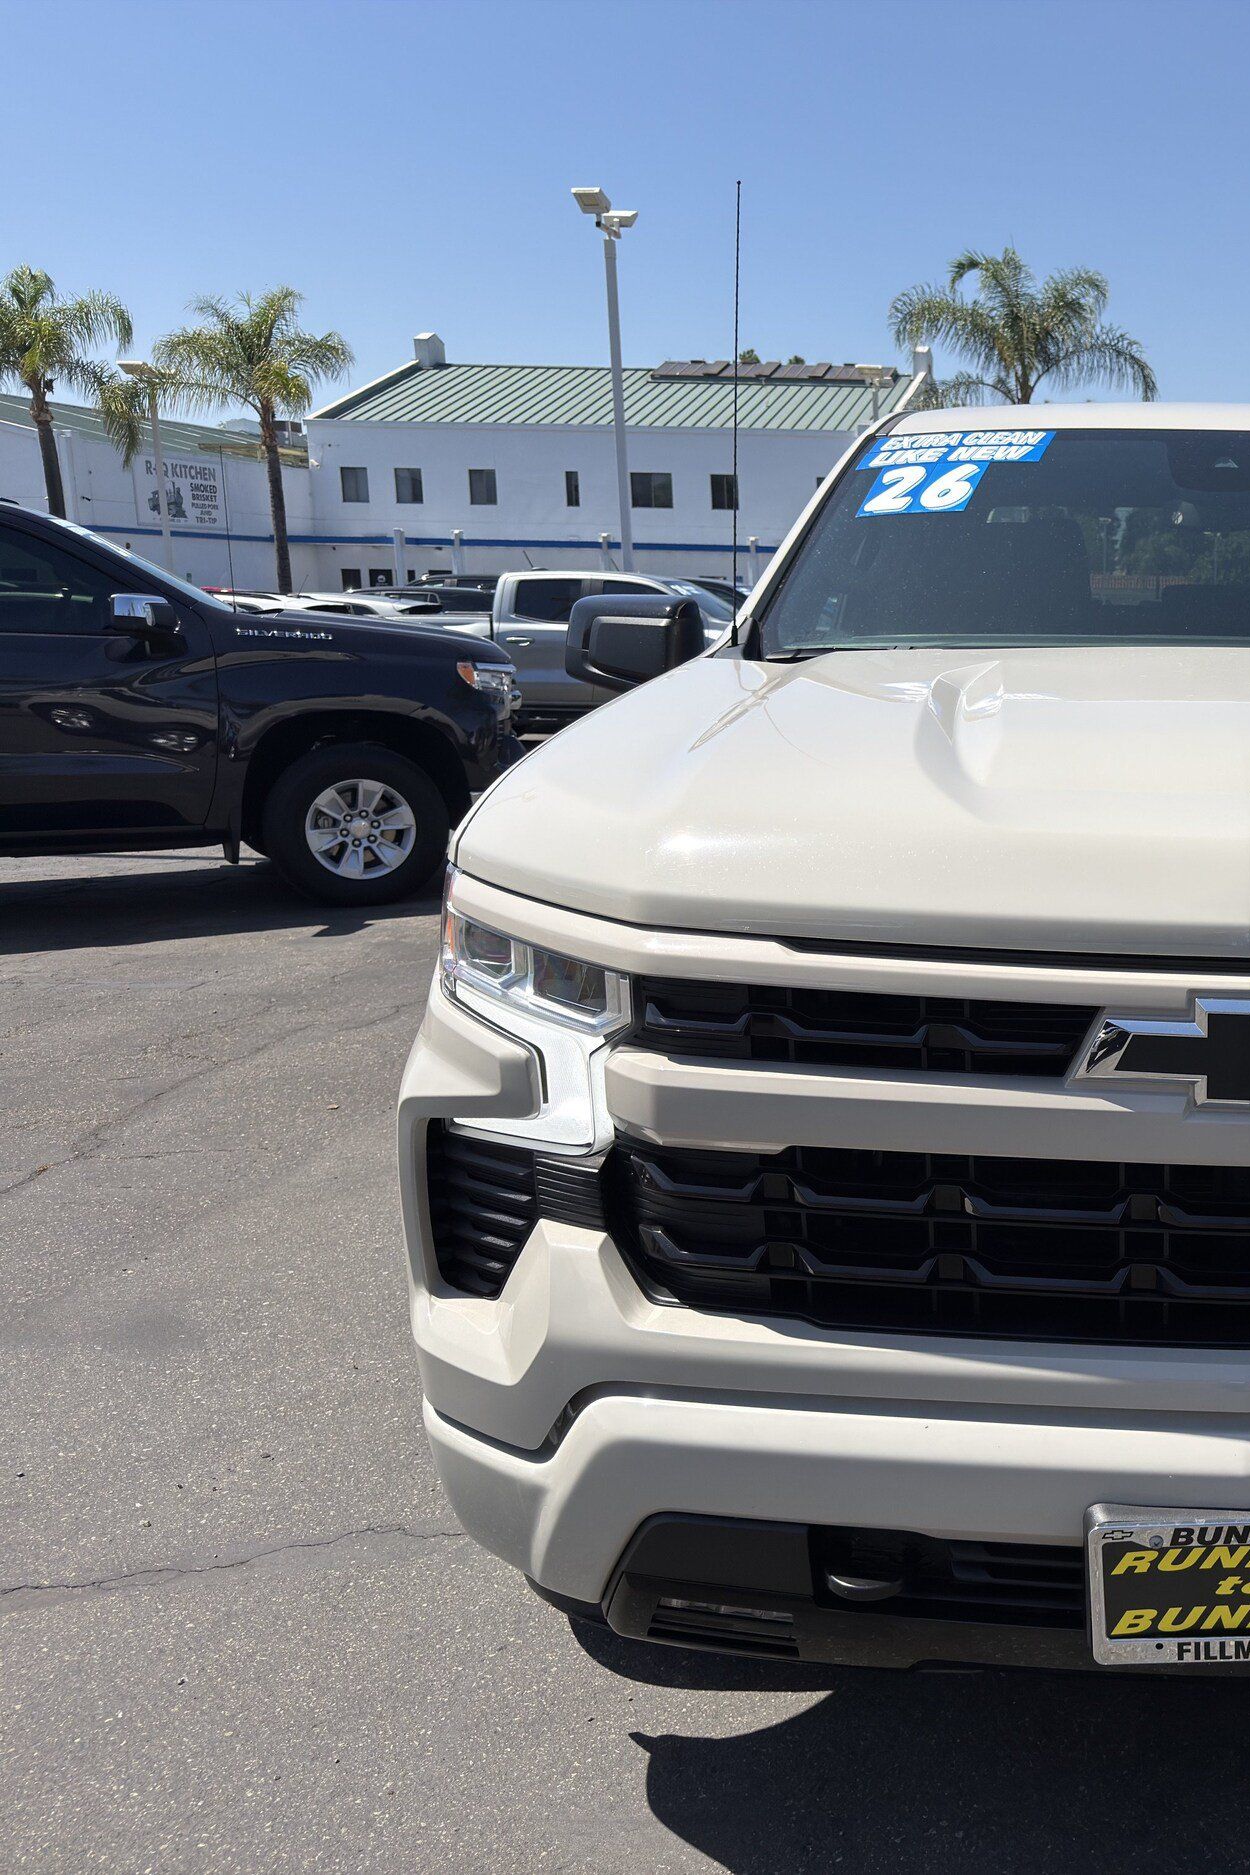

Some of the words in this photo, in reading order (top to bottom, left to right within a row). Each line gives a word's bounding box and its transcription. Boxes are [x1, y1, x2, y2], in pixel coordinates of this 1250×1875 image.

[880, 433, 960, 451] EXTRA
[963, 431, 1046, 446] CLEAN
[869, 447, 948, 467] LIKE
[947, 445, 1035, 462] NEW
[171, 462, 216, 482] KITCHEN
[190, 482, 217, 494] SMOKED
[863, 463, 981, 513] 26
[191, 493, 217, 502] BRISKET
[195, 516, 217, 525] TRI-TIP
[236, 628, 333, 640] SILVERADO
